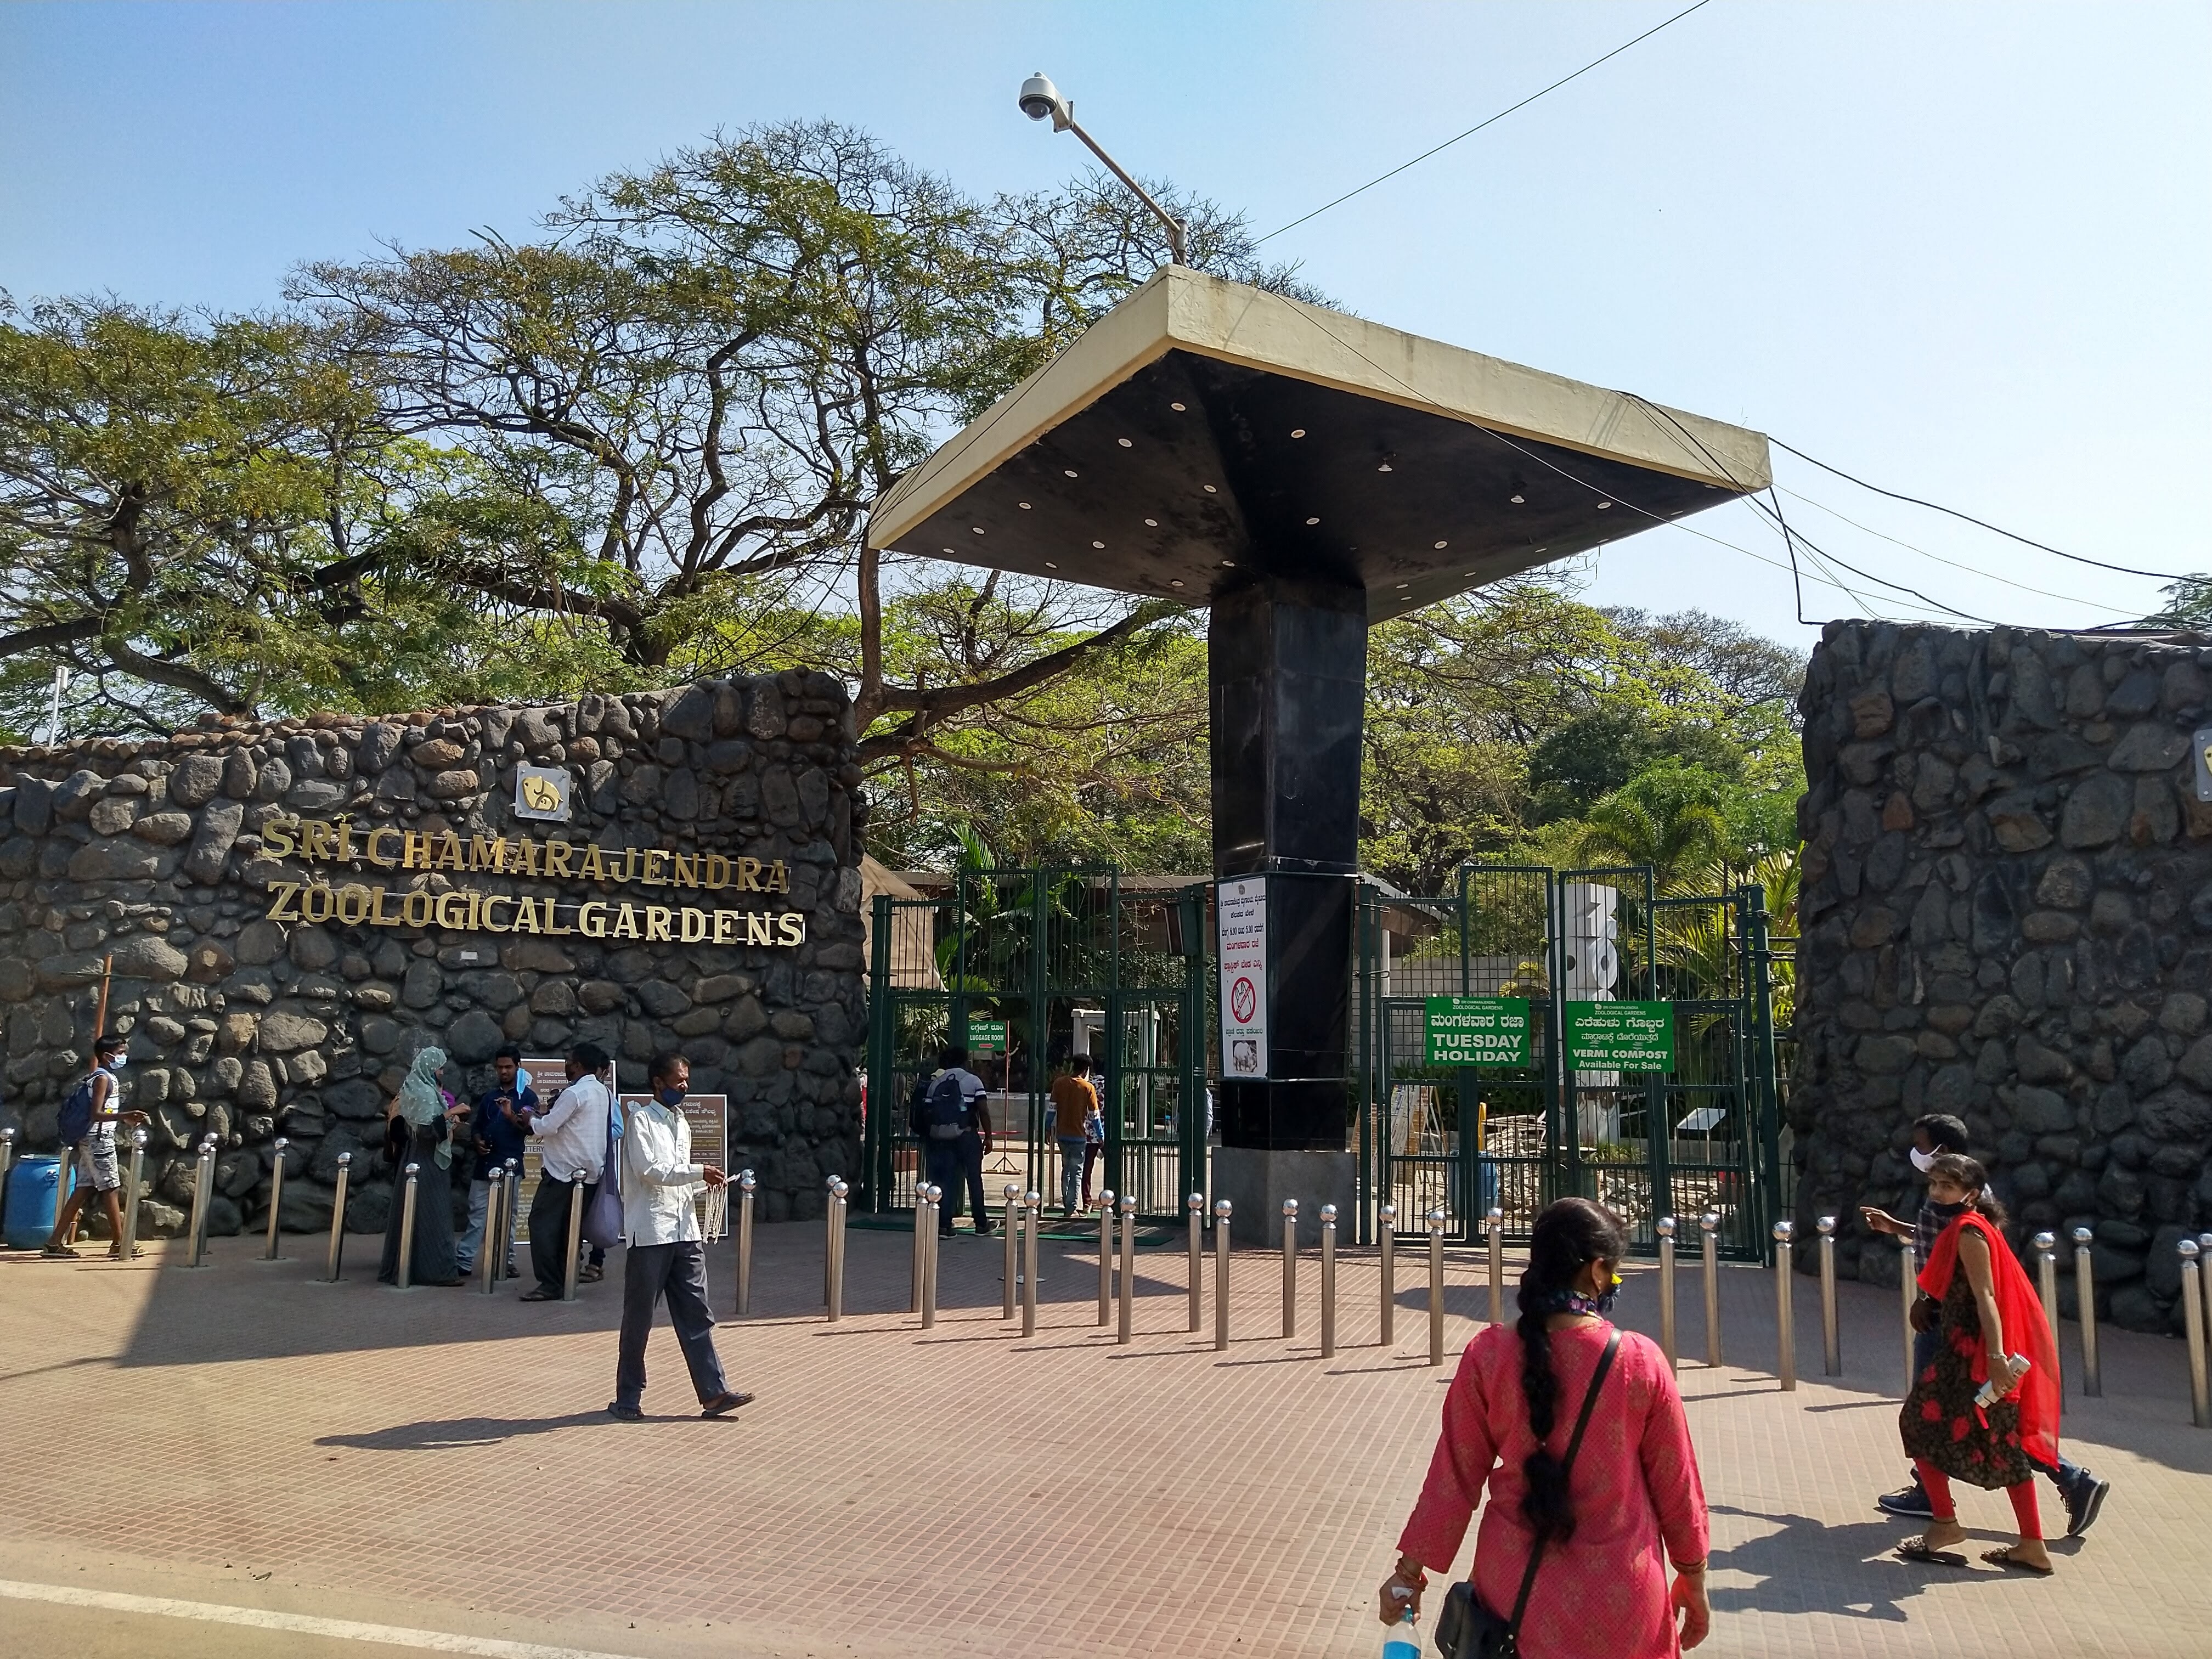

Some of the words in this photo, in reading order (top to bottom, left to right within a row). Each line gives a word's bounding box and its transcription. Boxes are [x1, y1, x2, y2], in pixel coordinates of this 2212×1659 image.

[262, 819, 352, 861] SRI
[367, 828, 790, 894] CHAMARAJENDRA
[266, 881, 571, 935] ZOOLOGICAL
[579, 901, 804, 946] GARDENS
[1227, 940, 1250, 950] ಮಂಗಳವಾರ
[1431, 1012, 1495, 1027] ಮಂಗಳವಾರ
[1500, 1013, 1524, 1028] ರಜಾ
[1575, 1017, 1620, 1028] ಎರೆಹುಳು
[1626, 1017, 1664, 1033] ಗೊಬ್ಬರ
[1432, 1034, 1522, 1048] TUESDAY
[1617, 1032, 1658, 1043] ದೊರೆಯುತ್ತದೆ
[1434, 1051, 1521, 1062] HOLIDAY
[1573, 1049, 1608, 1058] VERMI
[1612, 1050, 1668, 1059] COMPOST
